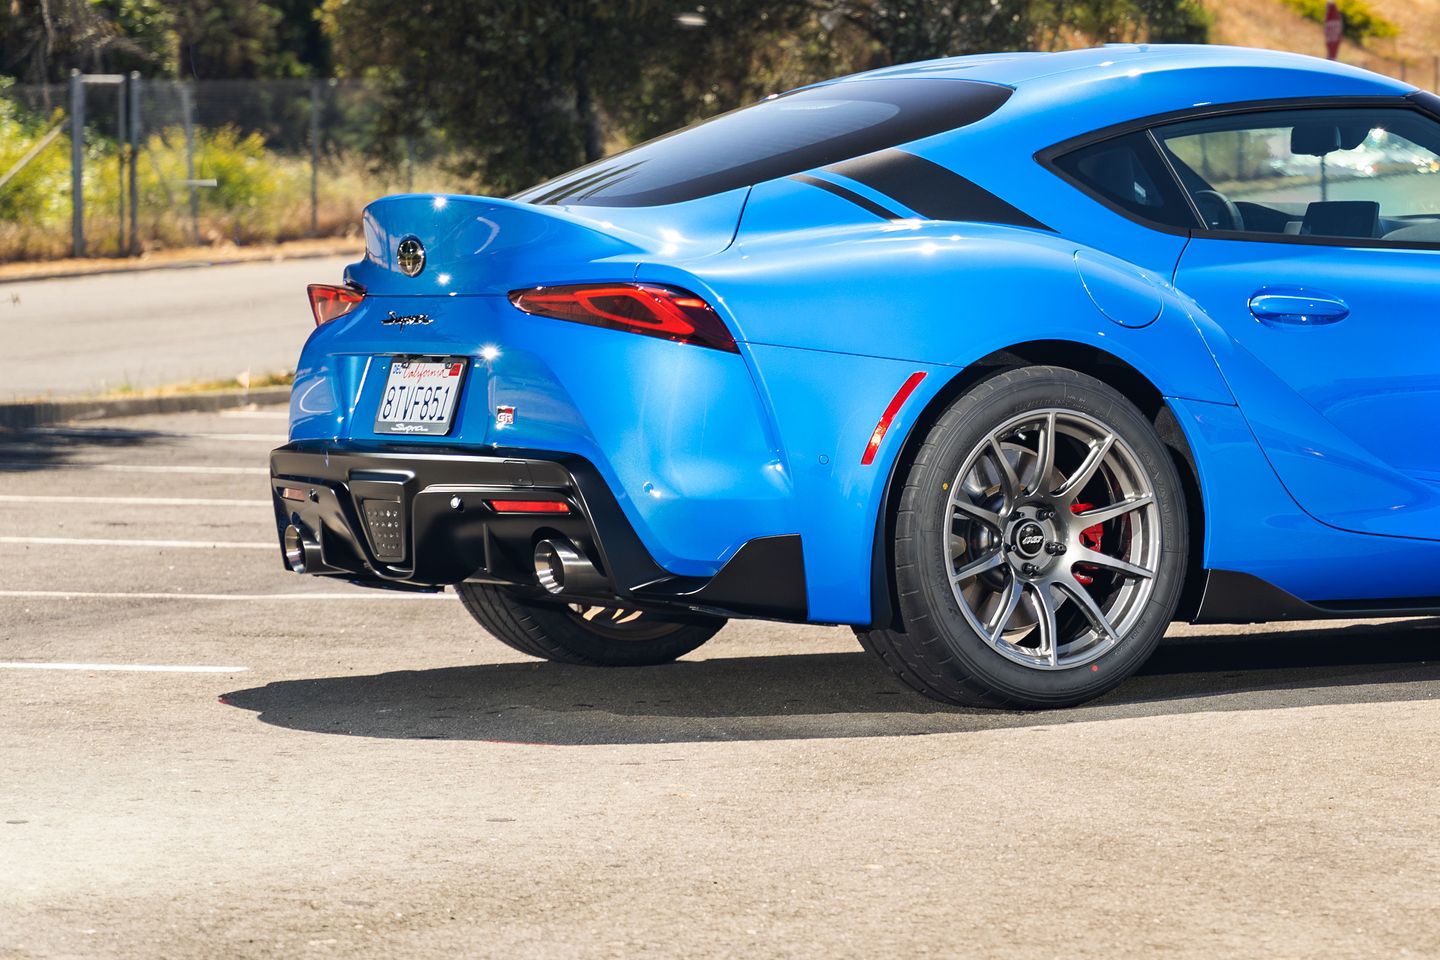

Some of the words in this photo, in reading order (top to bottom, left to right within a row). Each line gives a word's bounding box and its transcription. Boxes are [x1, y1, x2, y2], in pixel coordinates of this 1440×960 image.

[381, 310, 434, 333] Supra
[403, 362, 449, 384] California
[383, 385, 450, 421] 8TVF851
[390, 422, 429, 434] Supra
[497, 412, 513, 424] GR
